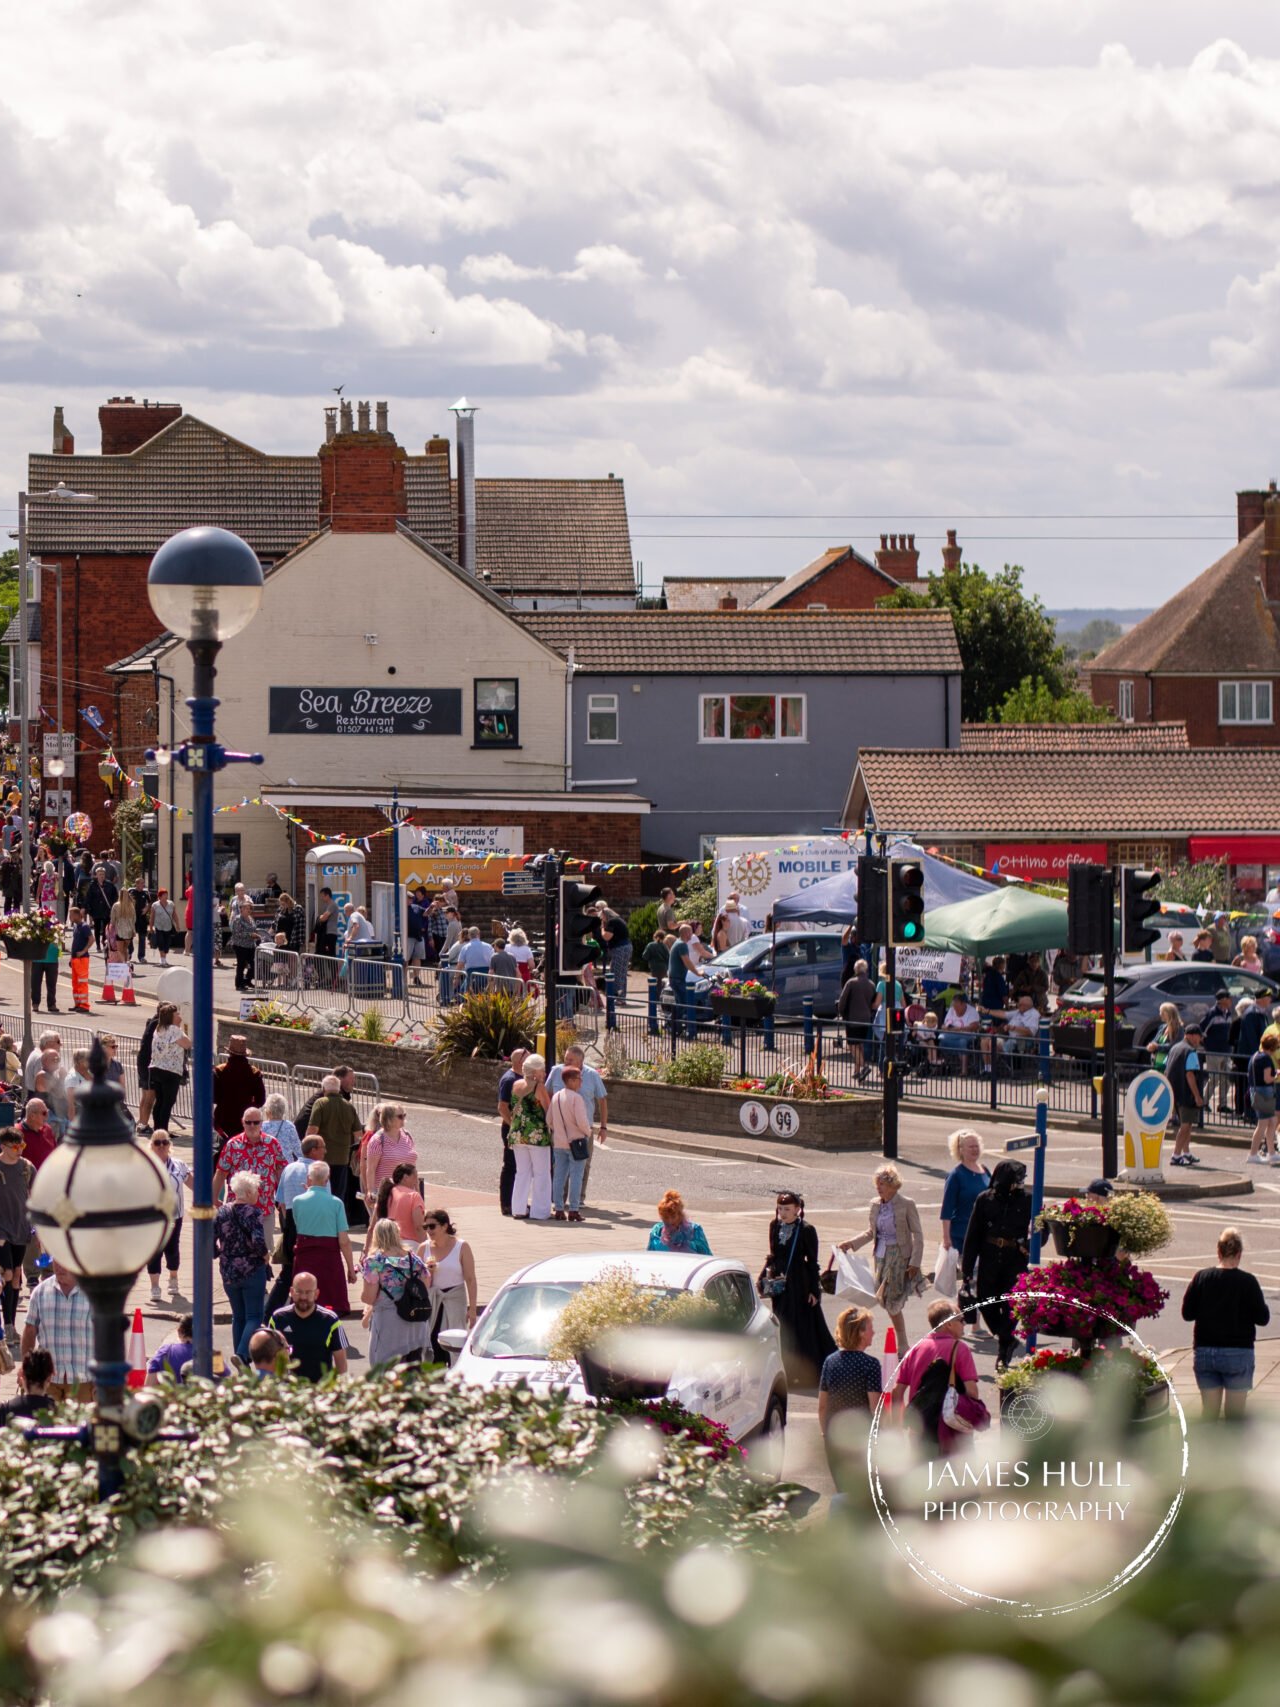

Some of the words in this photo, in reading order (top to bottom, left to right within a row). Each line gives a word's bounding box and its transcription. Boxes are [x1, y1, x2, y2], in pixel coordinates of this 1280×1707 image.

[299, 688, 343, 714] Sea
[350, 688, 433, 714] Breeze
[336, 714, 395, 726] Restaurant
[336, 725, 362, 734] 01507
[364, 725, 395, 734] 441548
[454, 827, 486, 836] Friends
[489, 827, 500, 836] of
[447, 836, 495, 846] Andrew's
[410, 845, 463, 856] Childres
[805, 848, 819, 856] Club
[821, 848, 827, 856] of
[829, 848, 848, 856] Alford
[778, 860, 842, 874] MOBILE
[999, 854, 1048, 869] Ottimo
[324, 865, 354, 875] CASH
[425, 871, 473, 887] Andy's
